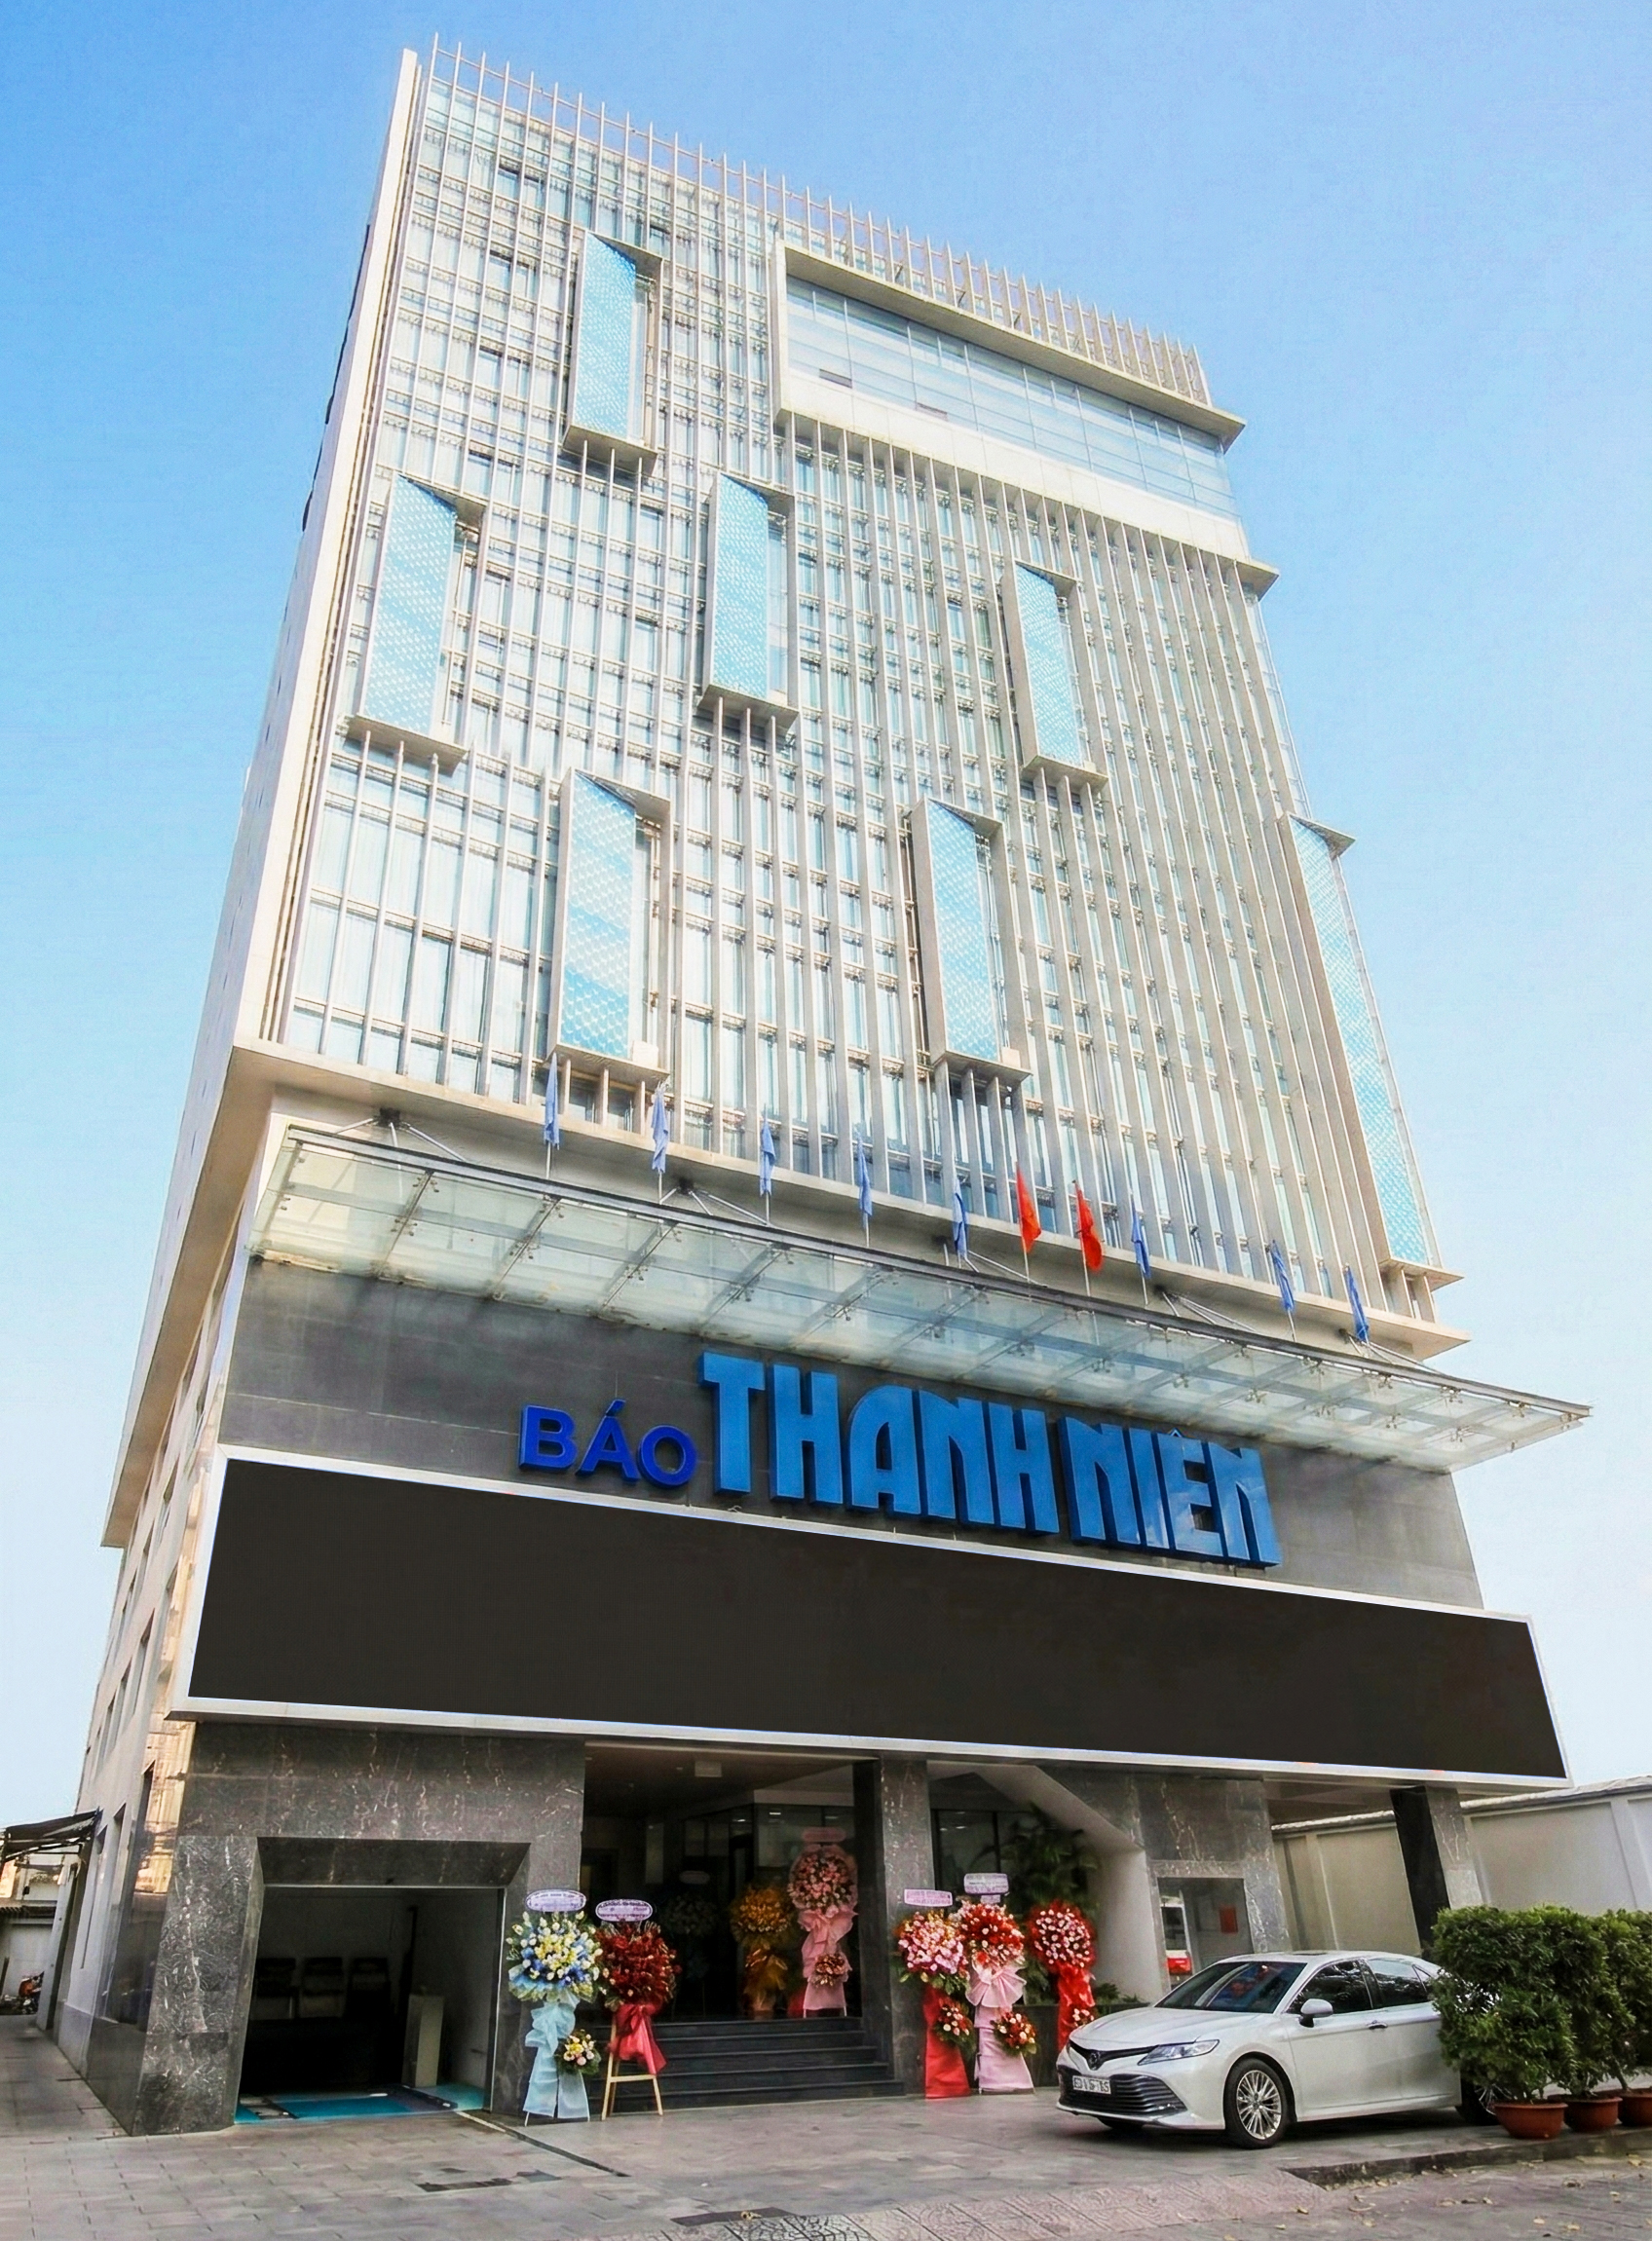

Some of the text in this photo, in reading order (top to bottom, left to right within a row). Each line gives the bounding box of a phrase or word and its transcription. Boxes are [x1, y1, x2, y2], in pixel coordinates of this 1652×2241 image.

[518, 1351, 1282, 1568] BÁO THANH NIÊN
